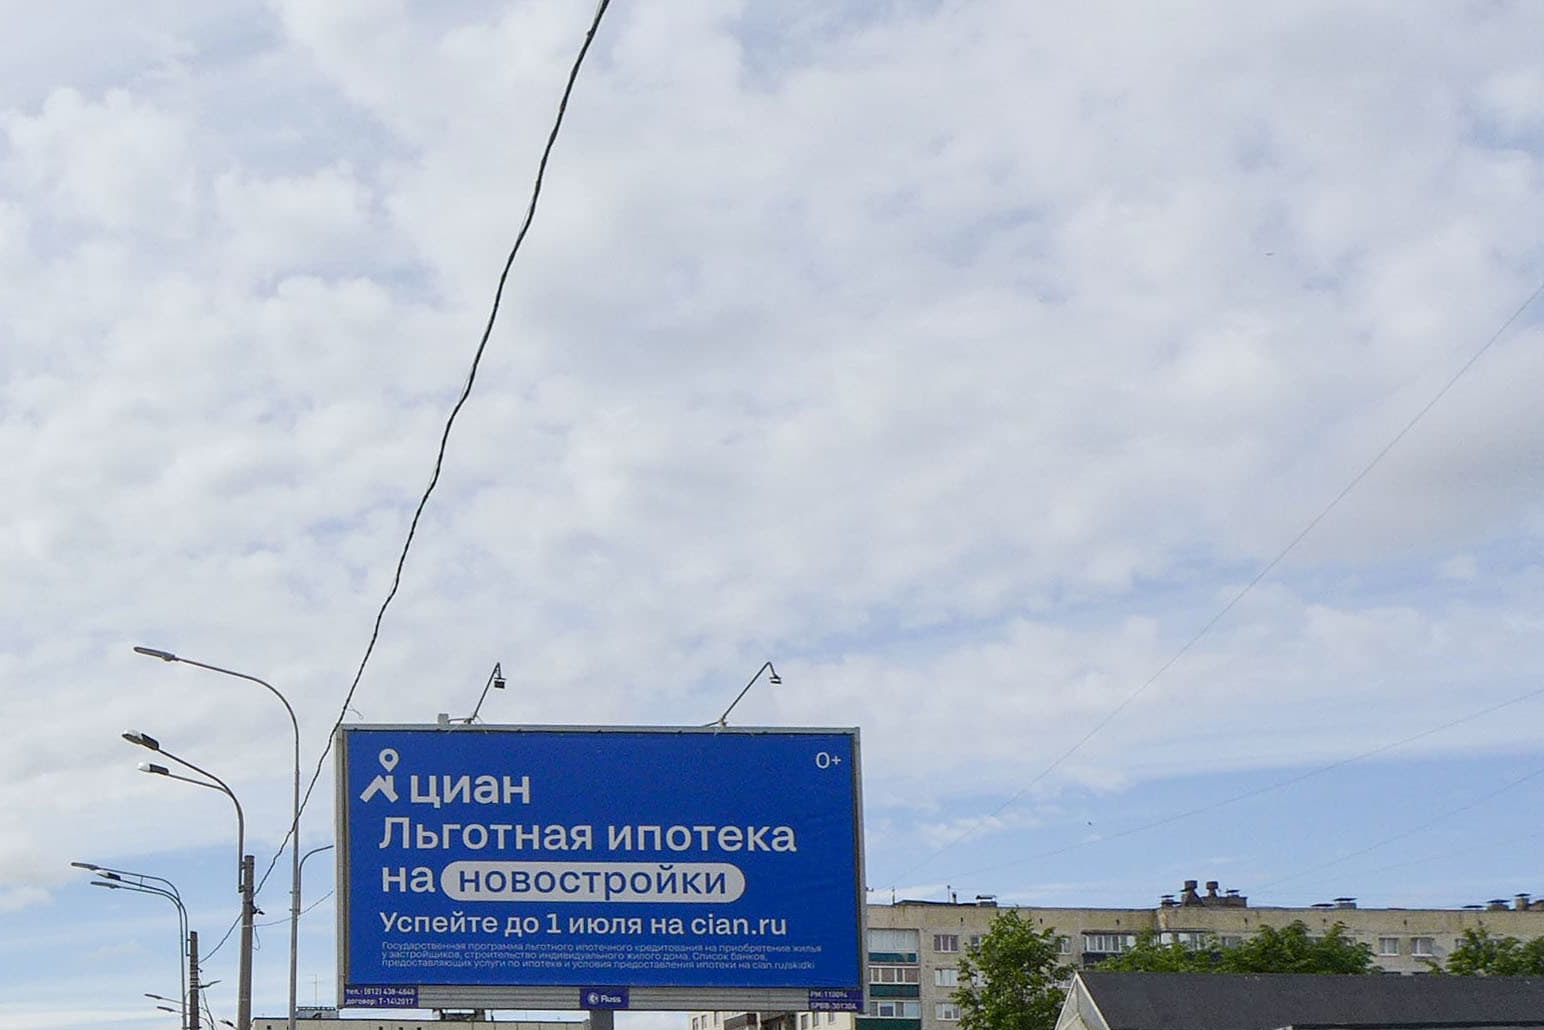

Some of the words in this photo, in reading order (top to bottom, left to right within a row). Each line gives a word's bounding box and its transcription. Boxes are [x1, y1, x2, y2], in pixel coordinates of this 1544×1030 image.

[815, 752, 841, 769] 0+
[410, 775, 530, 809] циан
[379, 817, 592, 850] Льготная
[608, 825, 797, 852] ипотека
[382, 866, 436, 893] на
[459, 864, 726, 899] новостройки
[379, 911, 498, 933] Успейте
[504, 917, 539, 936] до
[546, 913, 560, 934] 1
[569, 917, 642, 934] июля
[651, 918, 684, 935] на
[691, 913, 786, 935] cian.ru
[382, 942, 466, 951] Государственная
[468, 943, 523, 952] программа
[525, 943, 573, 951] льготного
[576, 943, 632, 951] ипотечного
[635, 943, 703, 953] кредитования
[719, 943, 790, 953] приобретение
[464, 951, 536, 960] строительство
[539, 951, 624, 961] индивидуального
[627, 953, 661, 961] жилого
[692, 952, 728, 962] Список
[382, 960, 472, 969] предоставляющих
[473, 960, 505, 969] услуги
[508, 961, 520, 969] по
[571, 961, 612, 970] условия
[615, 961, 694, 971] предоставления
[738, 962, 750, 970] на
